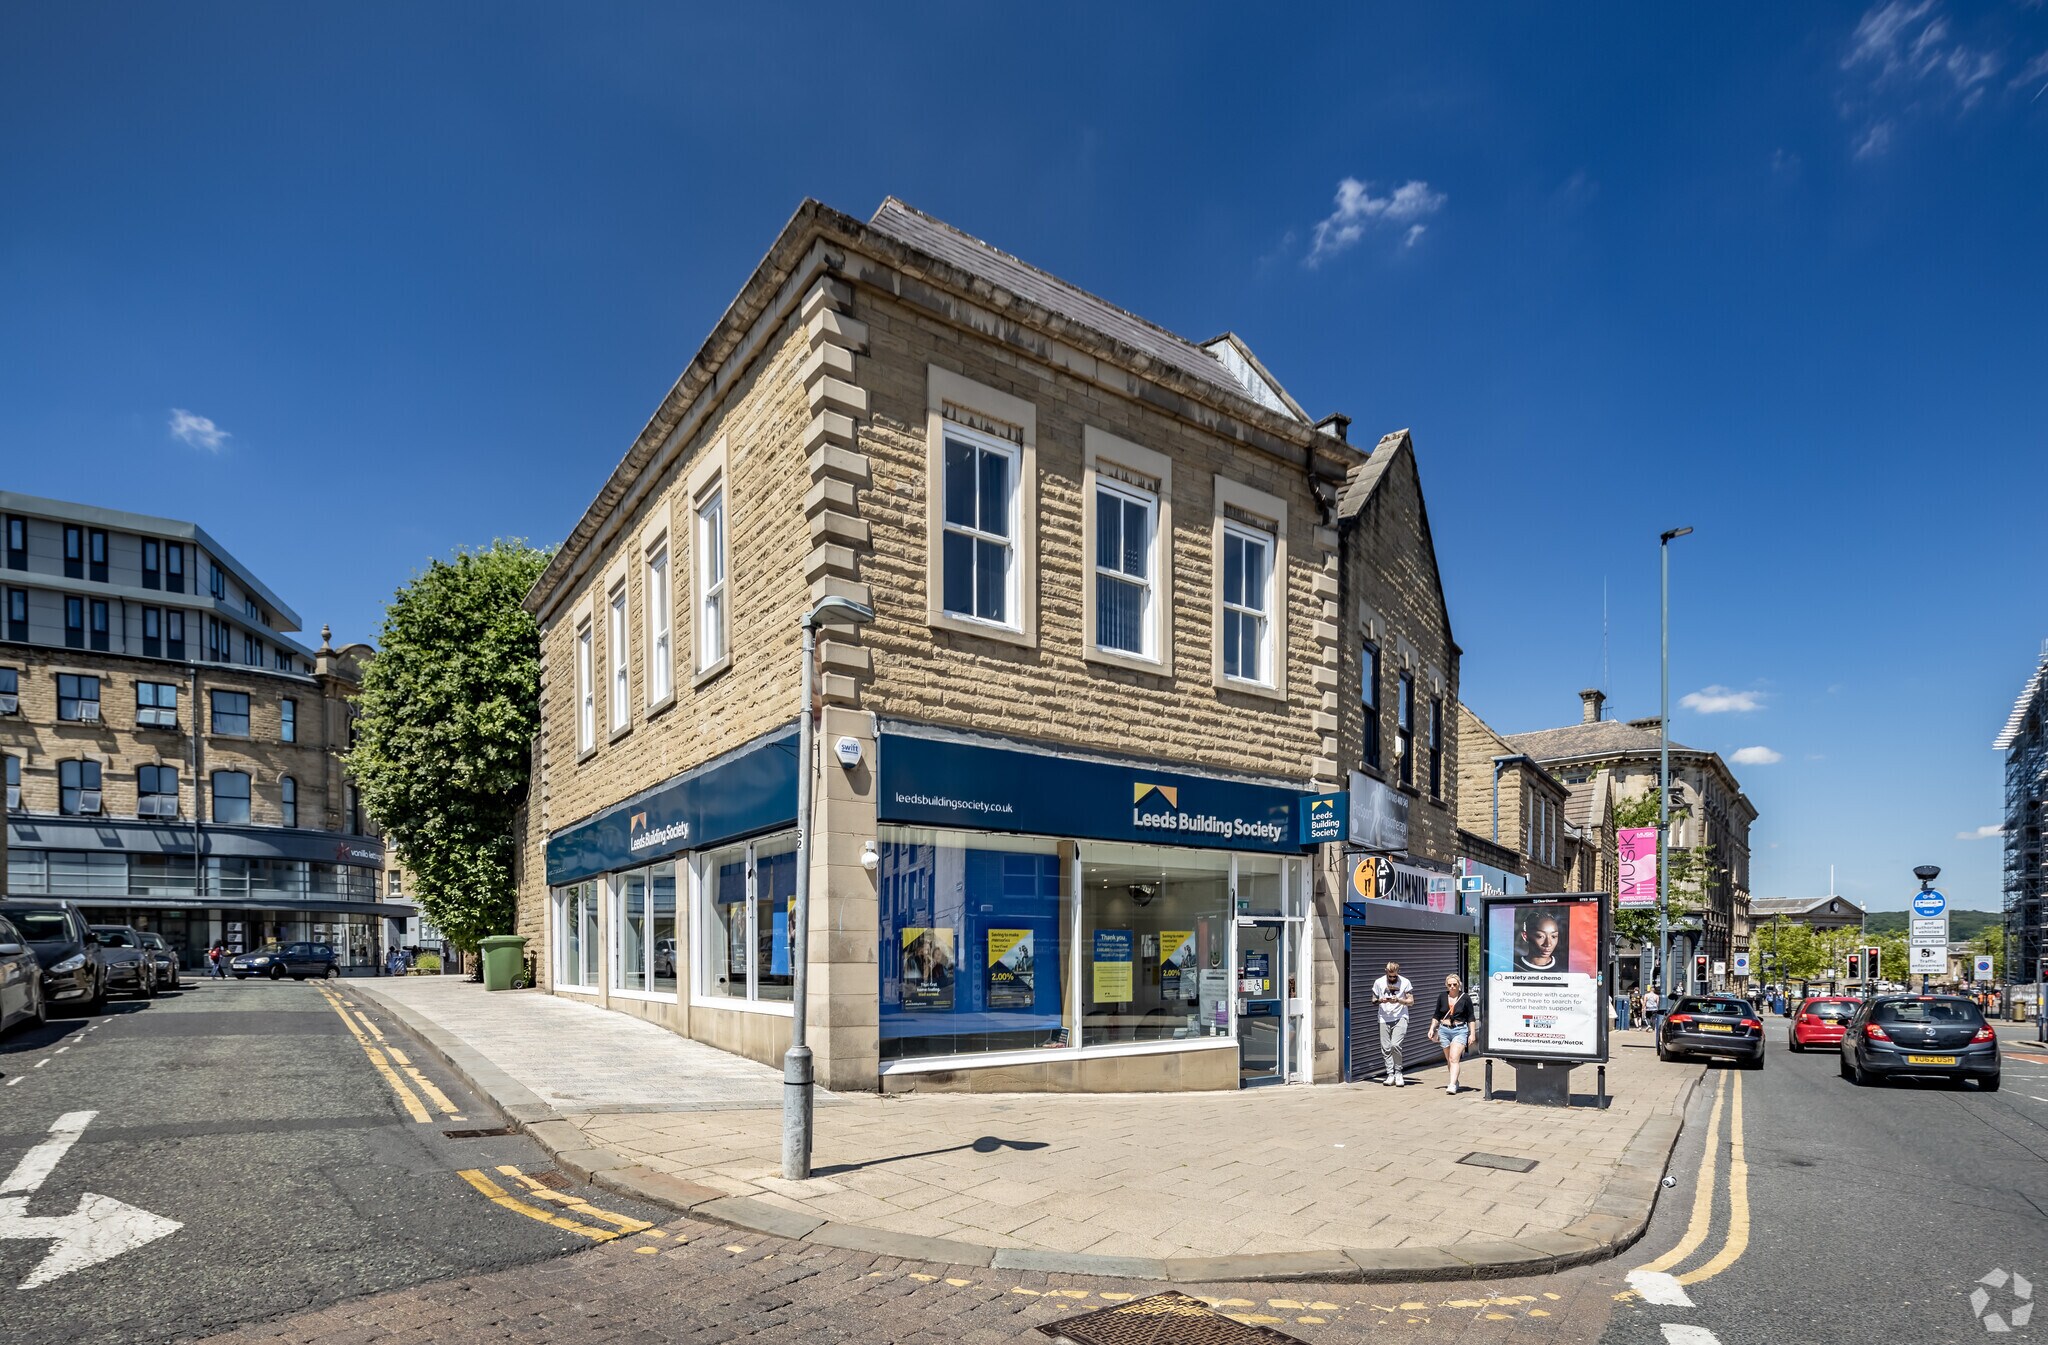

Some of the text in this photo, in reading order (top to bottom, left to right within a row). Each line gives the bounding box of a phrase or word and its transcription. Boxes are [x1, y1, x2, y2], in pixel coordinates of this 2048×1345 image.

[841, 743, 859, 752] swift
[895, 791, 1013, 813] leedsbuildingsociety.co.uk
[1311, 811, 1333, 821] Leeds
[1133, 807, 1282, 842] Leeds Building Society
[1311, 819, 1340, 829] Building
[630, 820, 689, 851] Leeds Building Society
[1311, 828, 1339, 838] Society
[1100, 933, 1116, 941] Thank
[991, 972, 1015, 981] 2.00%
[1163, 969, 1181, 977] 2.00%
[1497, 1036, 1584, 1046] teenagecancertrust.org/NotOK
